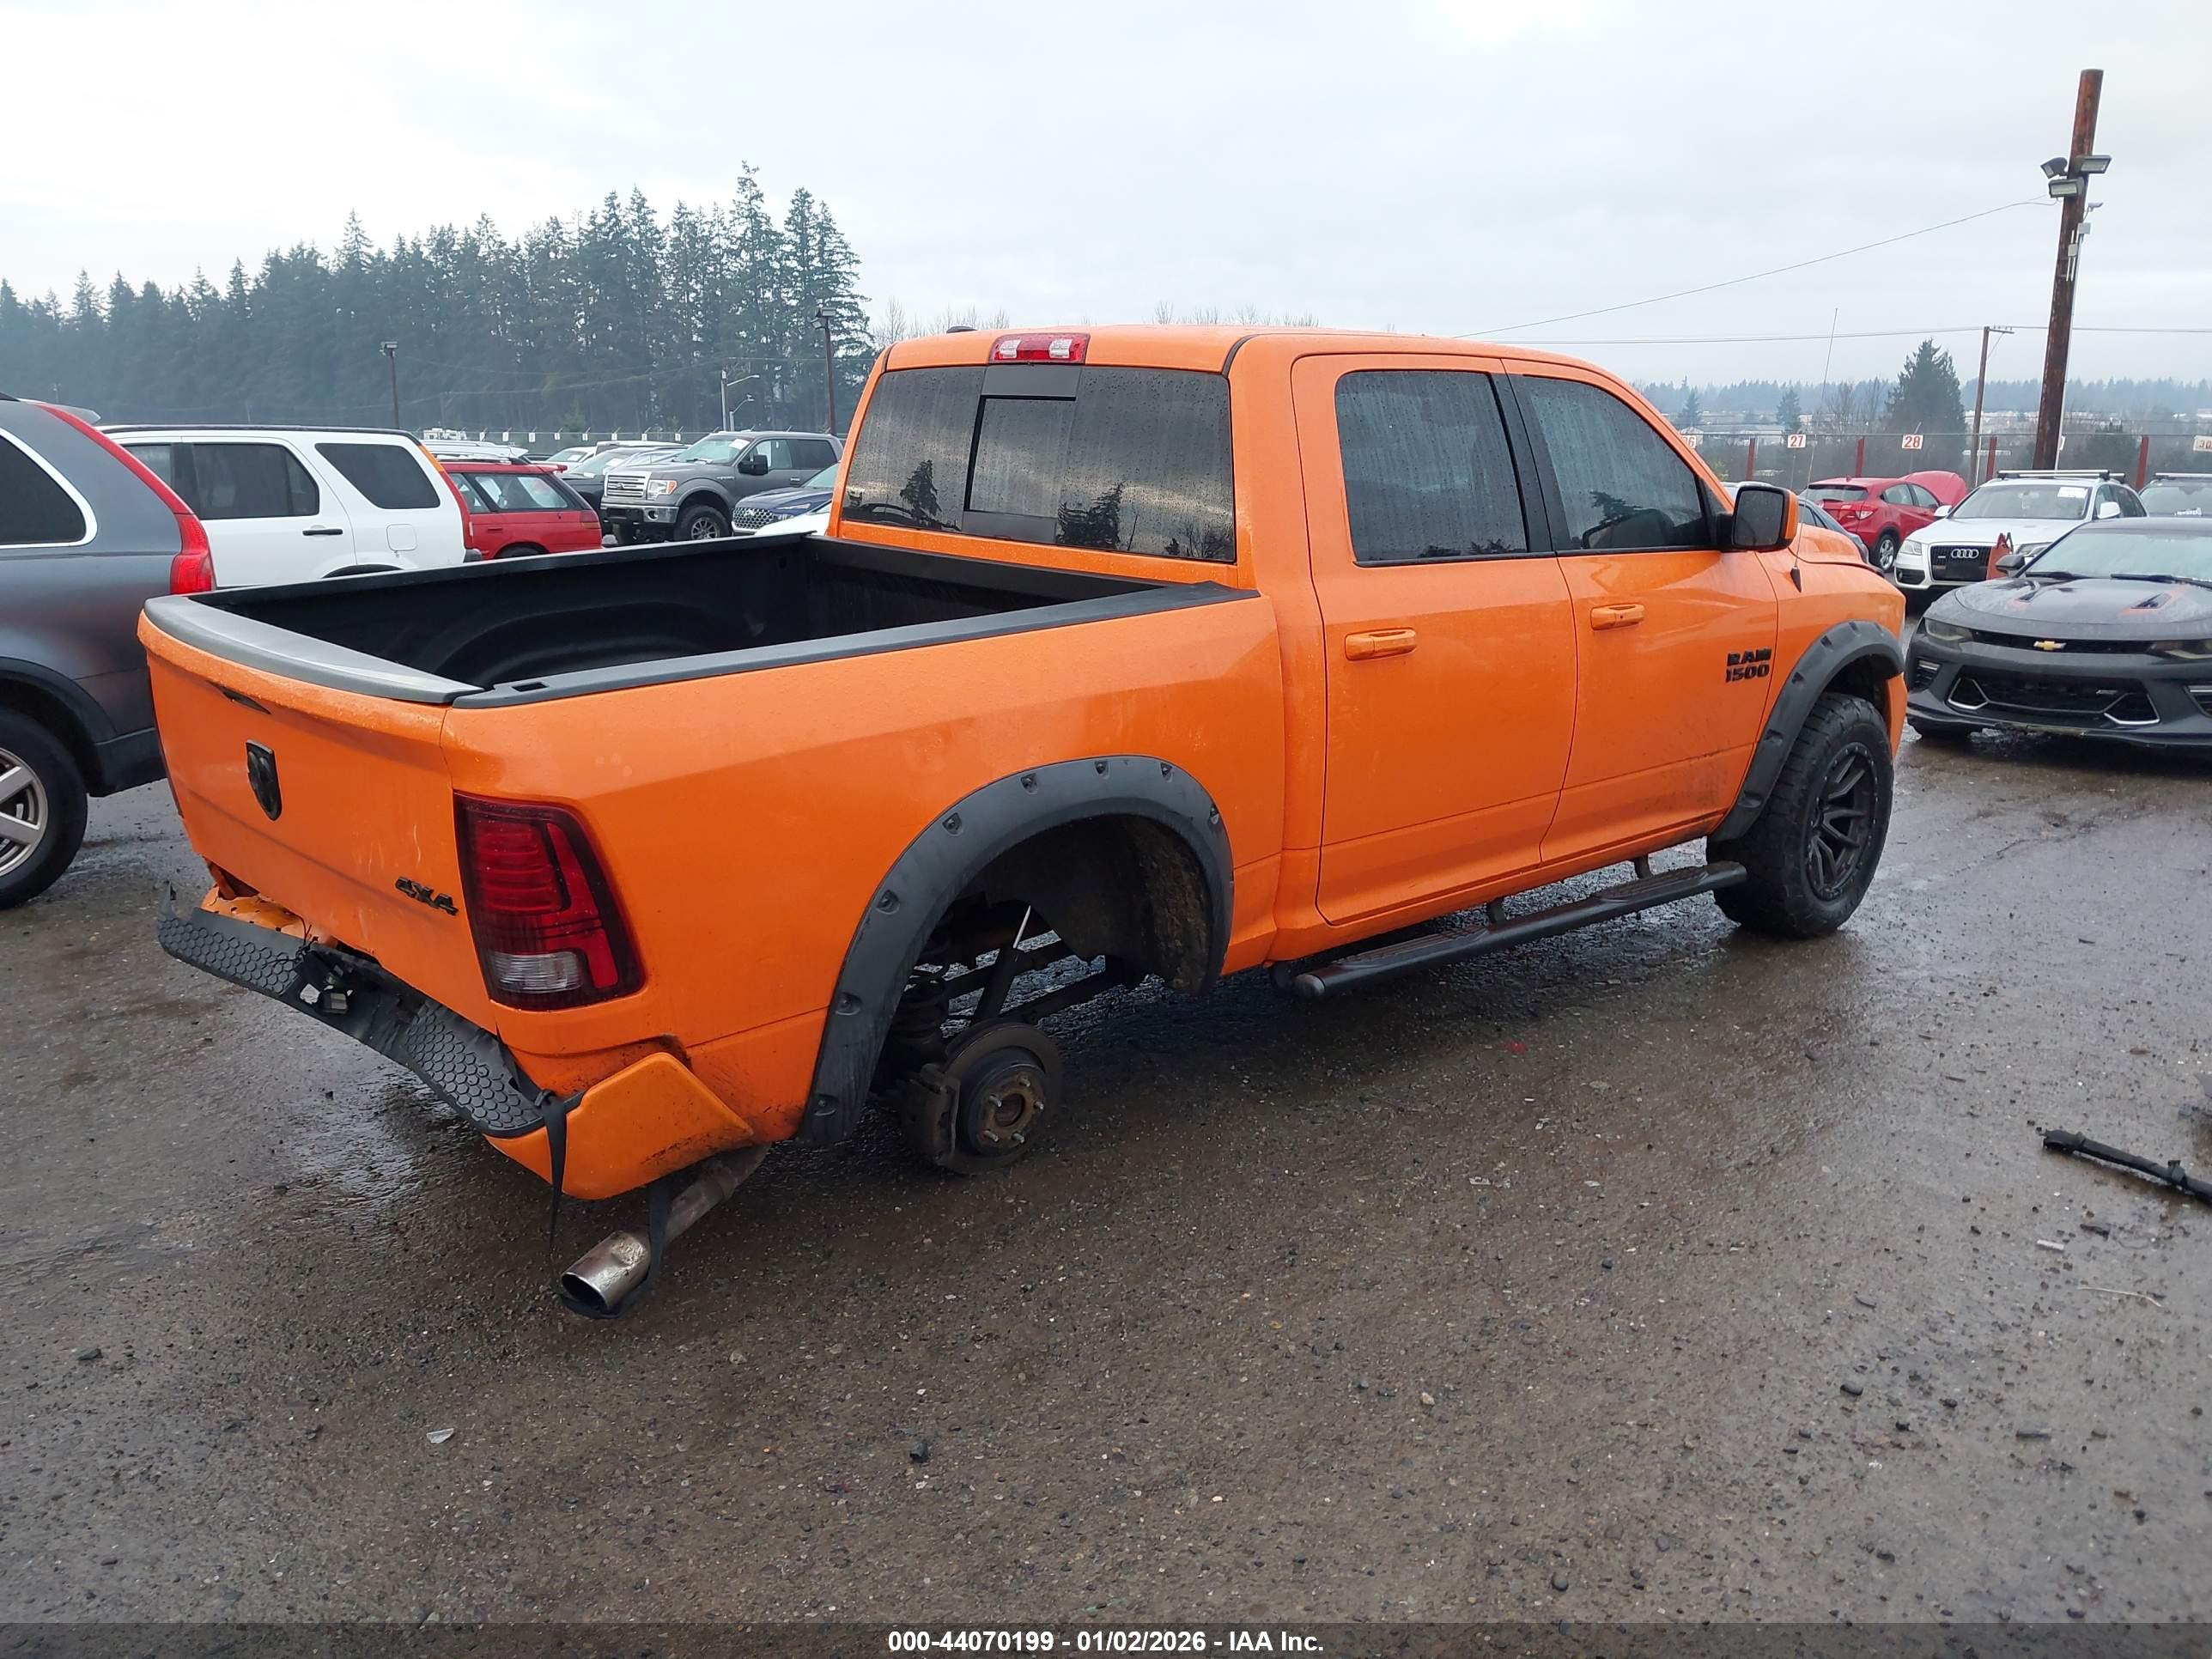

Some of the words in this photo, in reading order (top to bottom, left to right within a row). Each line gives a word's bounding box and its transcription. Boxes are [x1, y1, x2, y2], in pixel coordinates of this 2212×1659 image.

[1790, 435, 1803, 447] 27
[1905, 435, 1920, 447] 28
[1727, 648, 1772, 666] RAM
[1725, 665, 1771, 684] 1500
